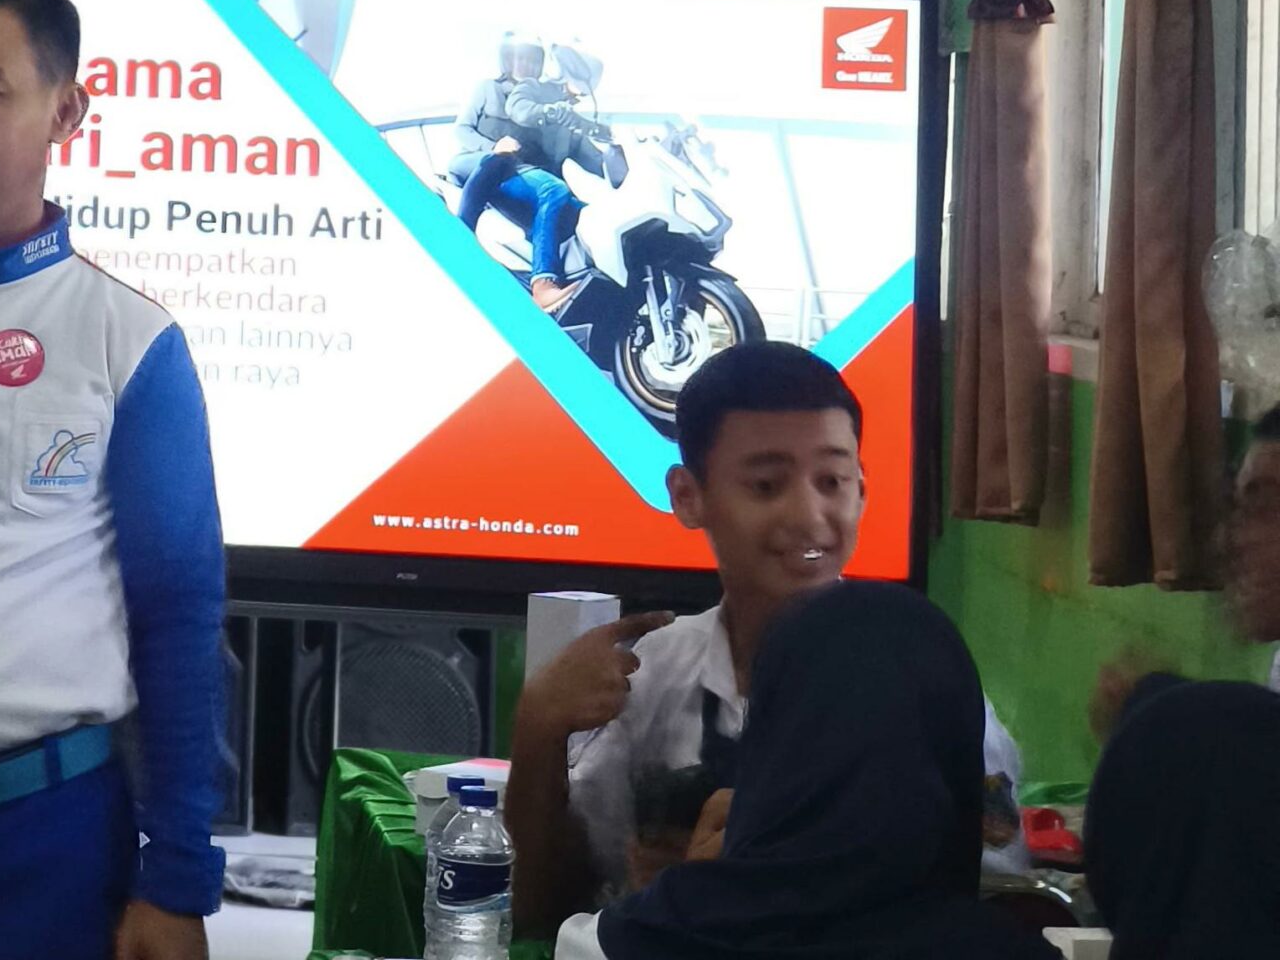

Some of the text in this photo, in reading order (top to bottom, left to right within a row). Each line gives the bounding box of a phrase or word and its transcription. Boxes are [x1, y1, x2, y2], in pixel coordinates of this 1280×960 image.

[84, 56, 223, 101] ama
[46, 113, 321, 178] ri_aman
[54, 194, 384, 241] idup Penuh Arti
[239, 319, 353, 357] lainnya
[233, 363, 302, 391] raya
[372, 513, 580, 536] www.astra-honda.com
